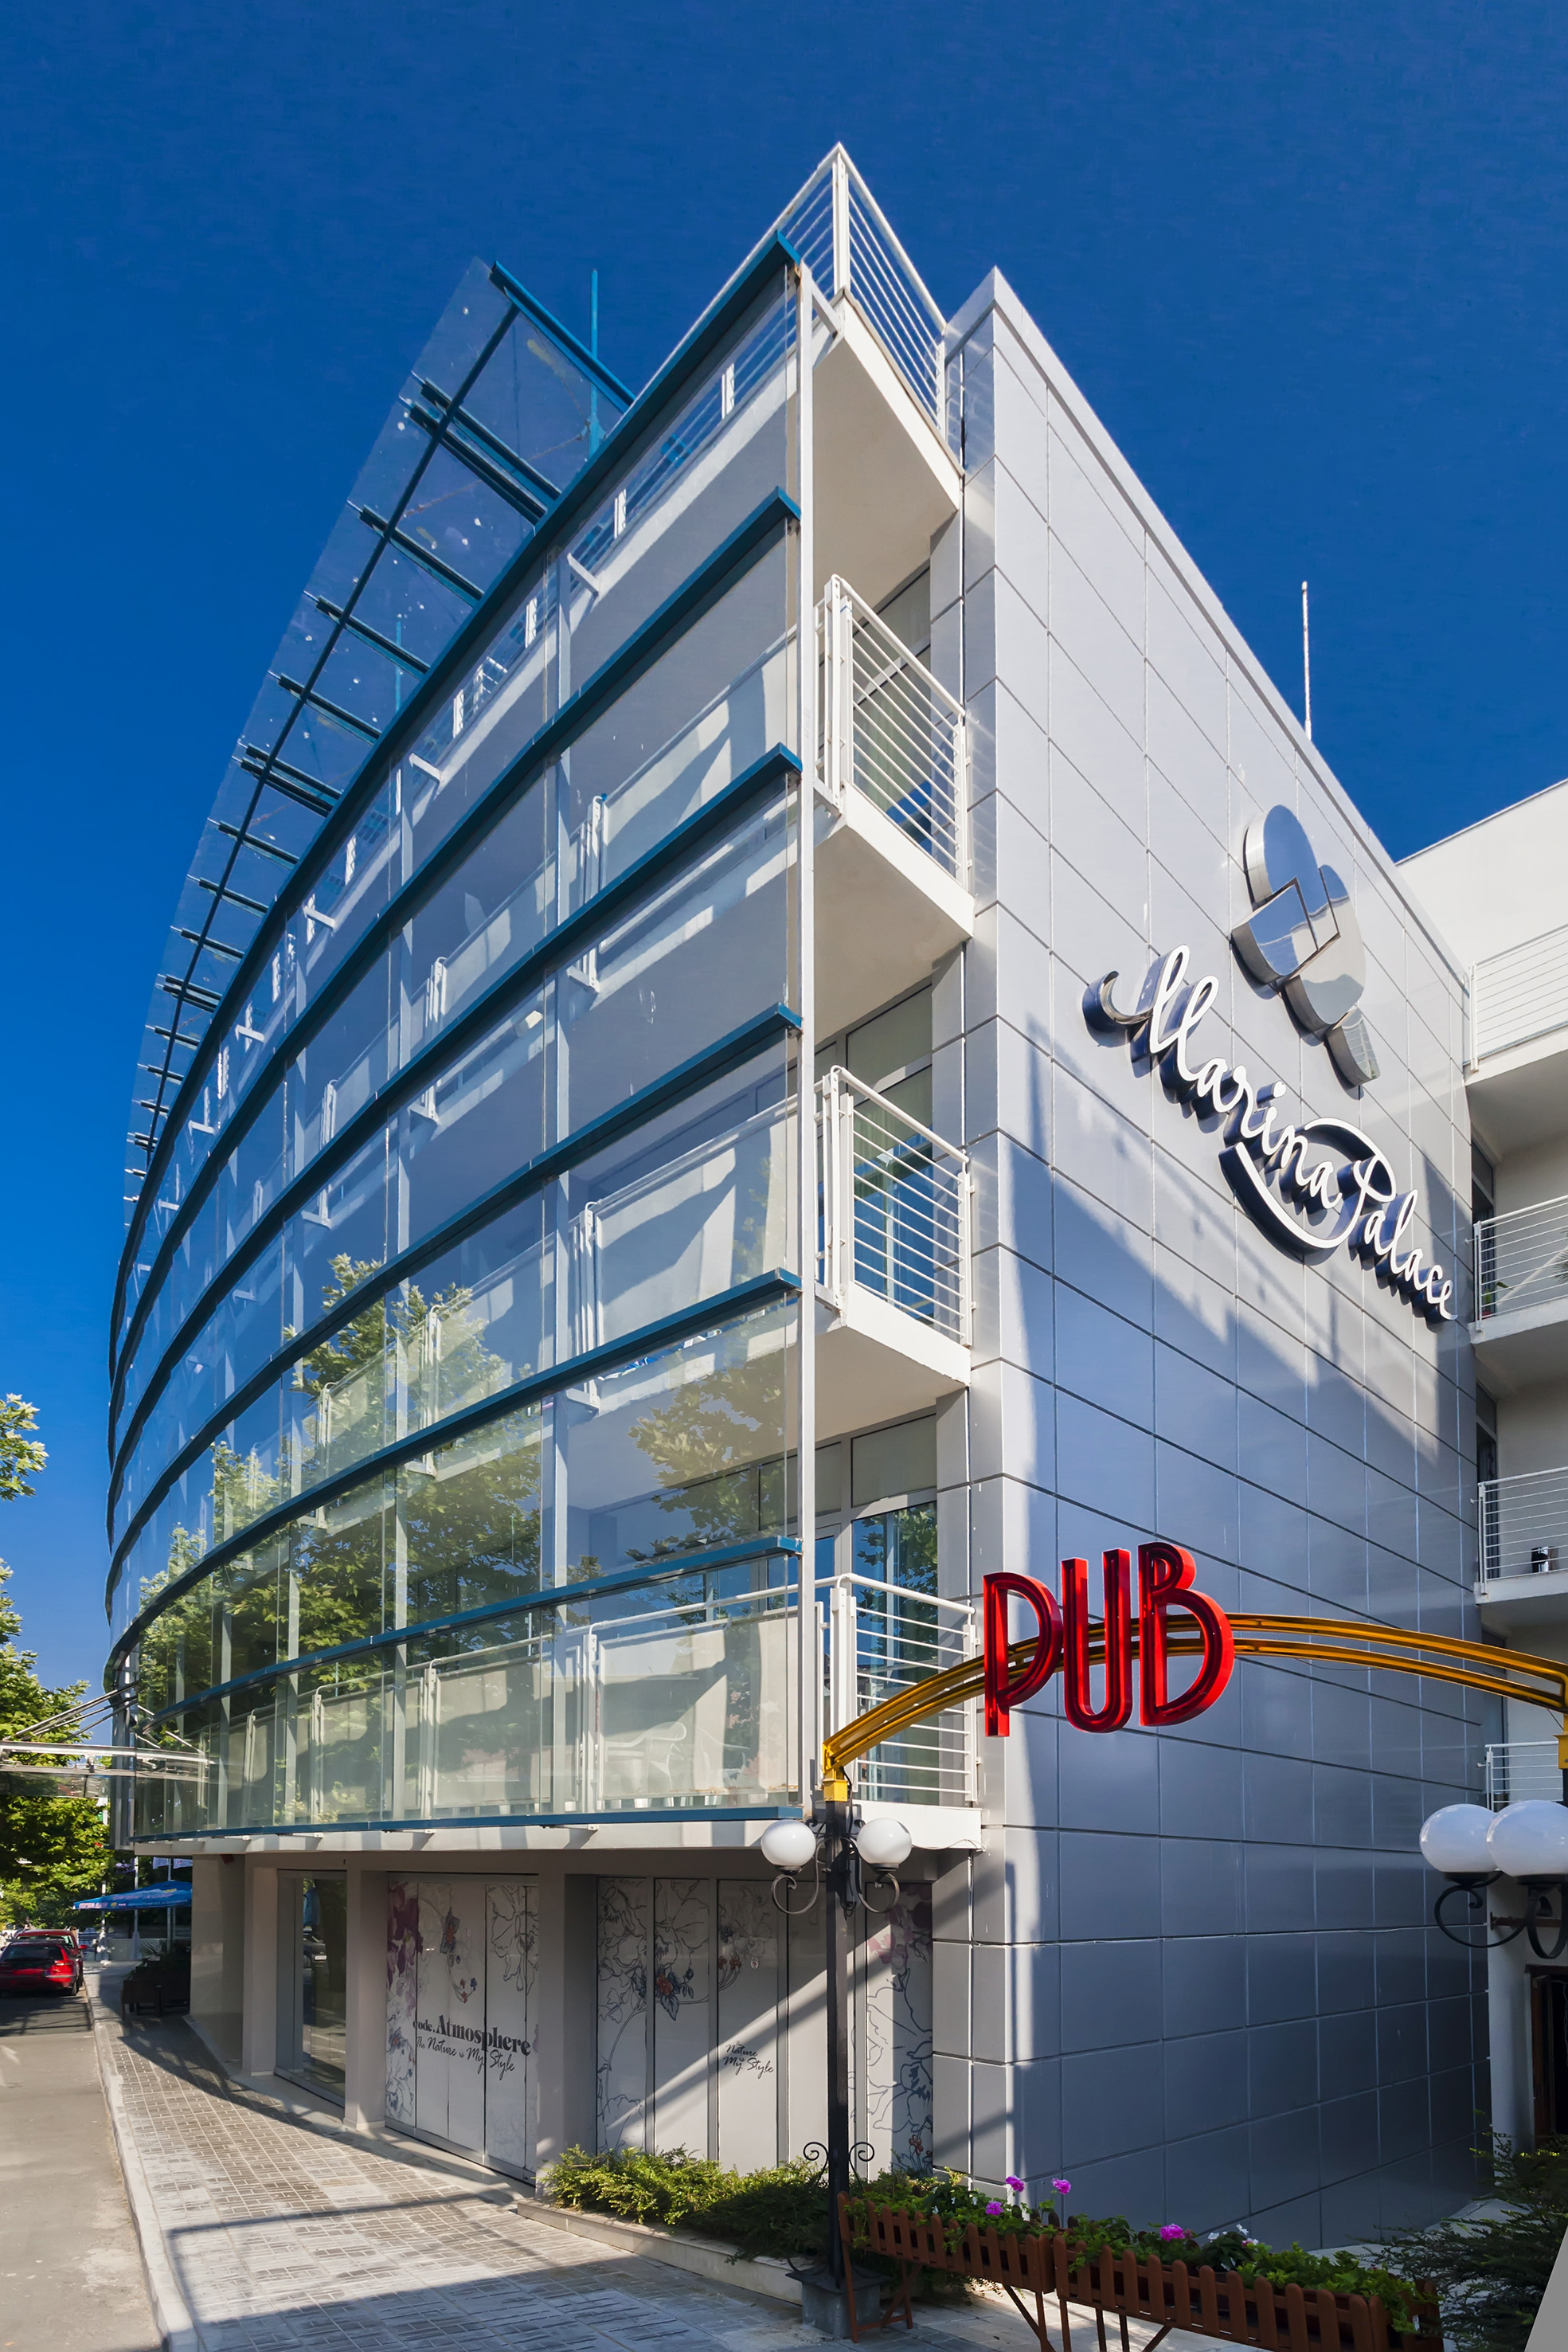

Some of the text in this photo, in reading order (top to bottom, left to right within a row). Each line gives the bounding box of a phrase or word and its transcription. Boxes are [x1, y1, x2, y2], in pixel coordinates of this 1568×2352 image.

[1082, 944, 1458, 1321] Marina Palace
[983, 1542, 1235, 1737] PUB
[416, 2036, 425, 2049] The
[427, 2037, 458, 2057] Nature
[467, 2047, 485, 2074] My
[489, 2049, 515, 2080] Style
[723, 2056, 774, 2079] My Style
[725, 2044, 758, 2057] Nature
